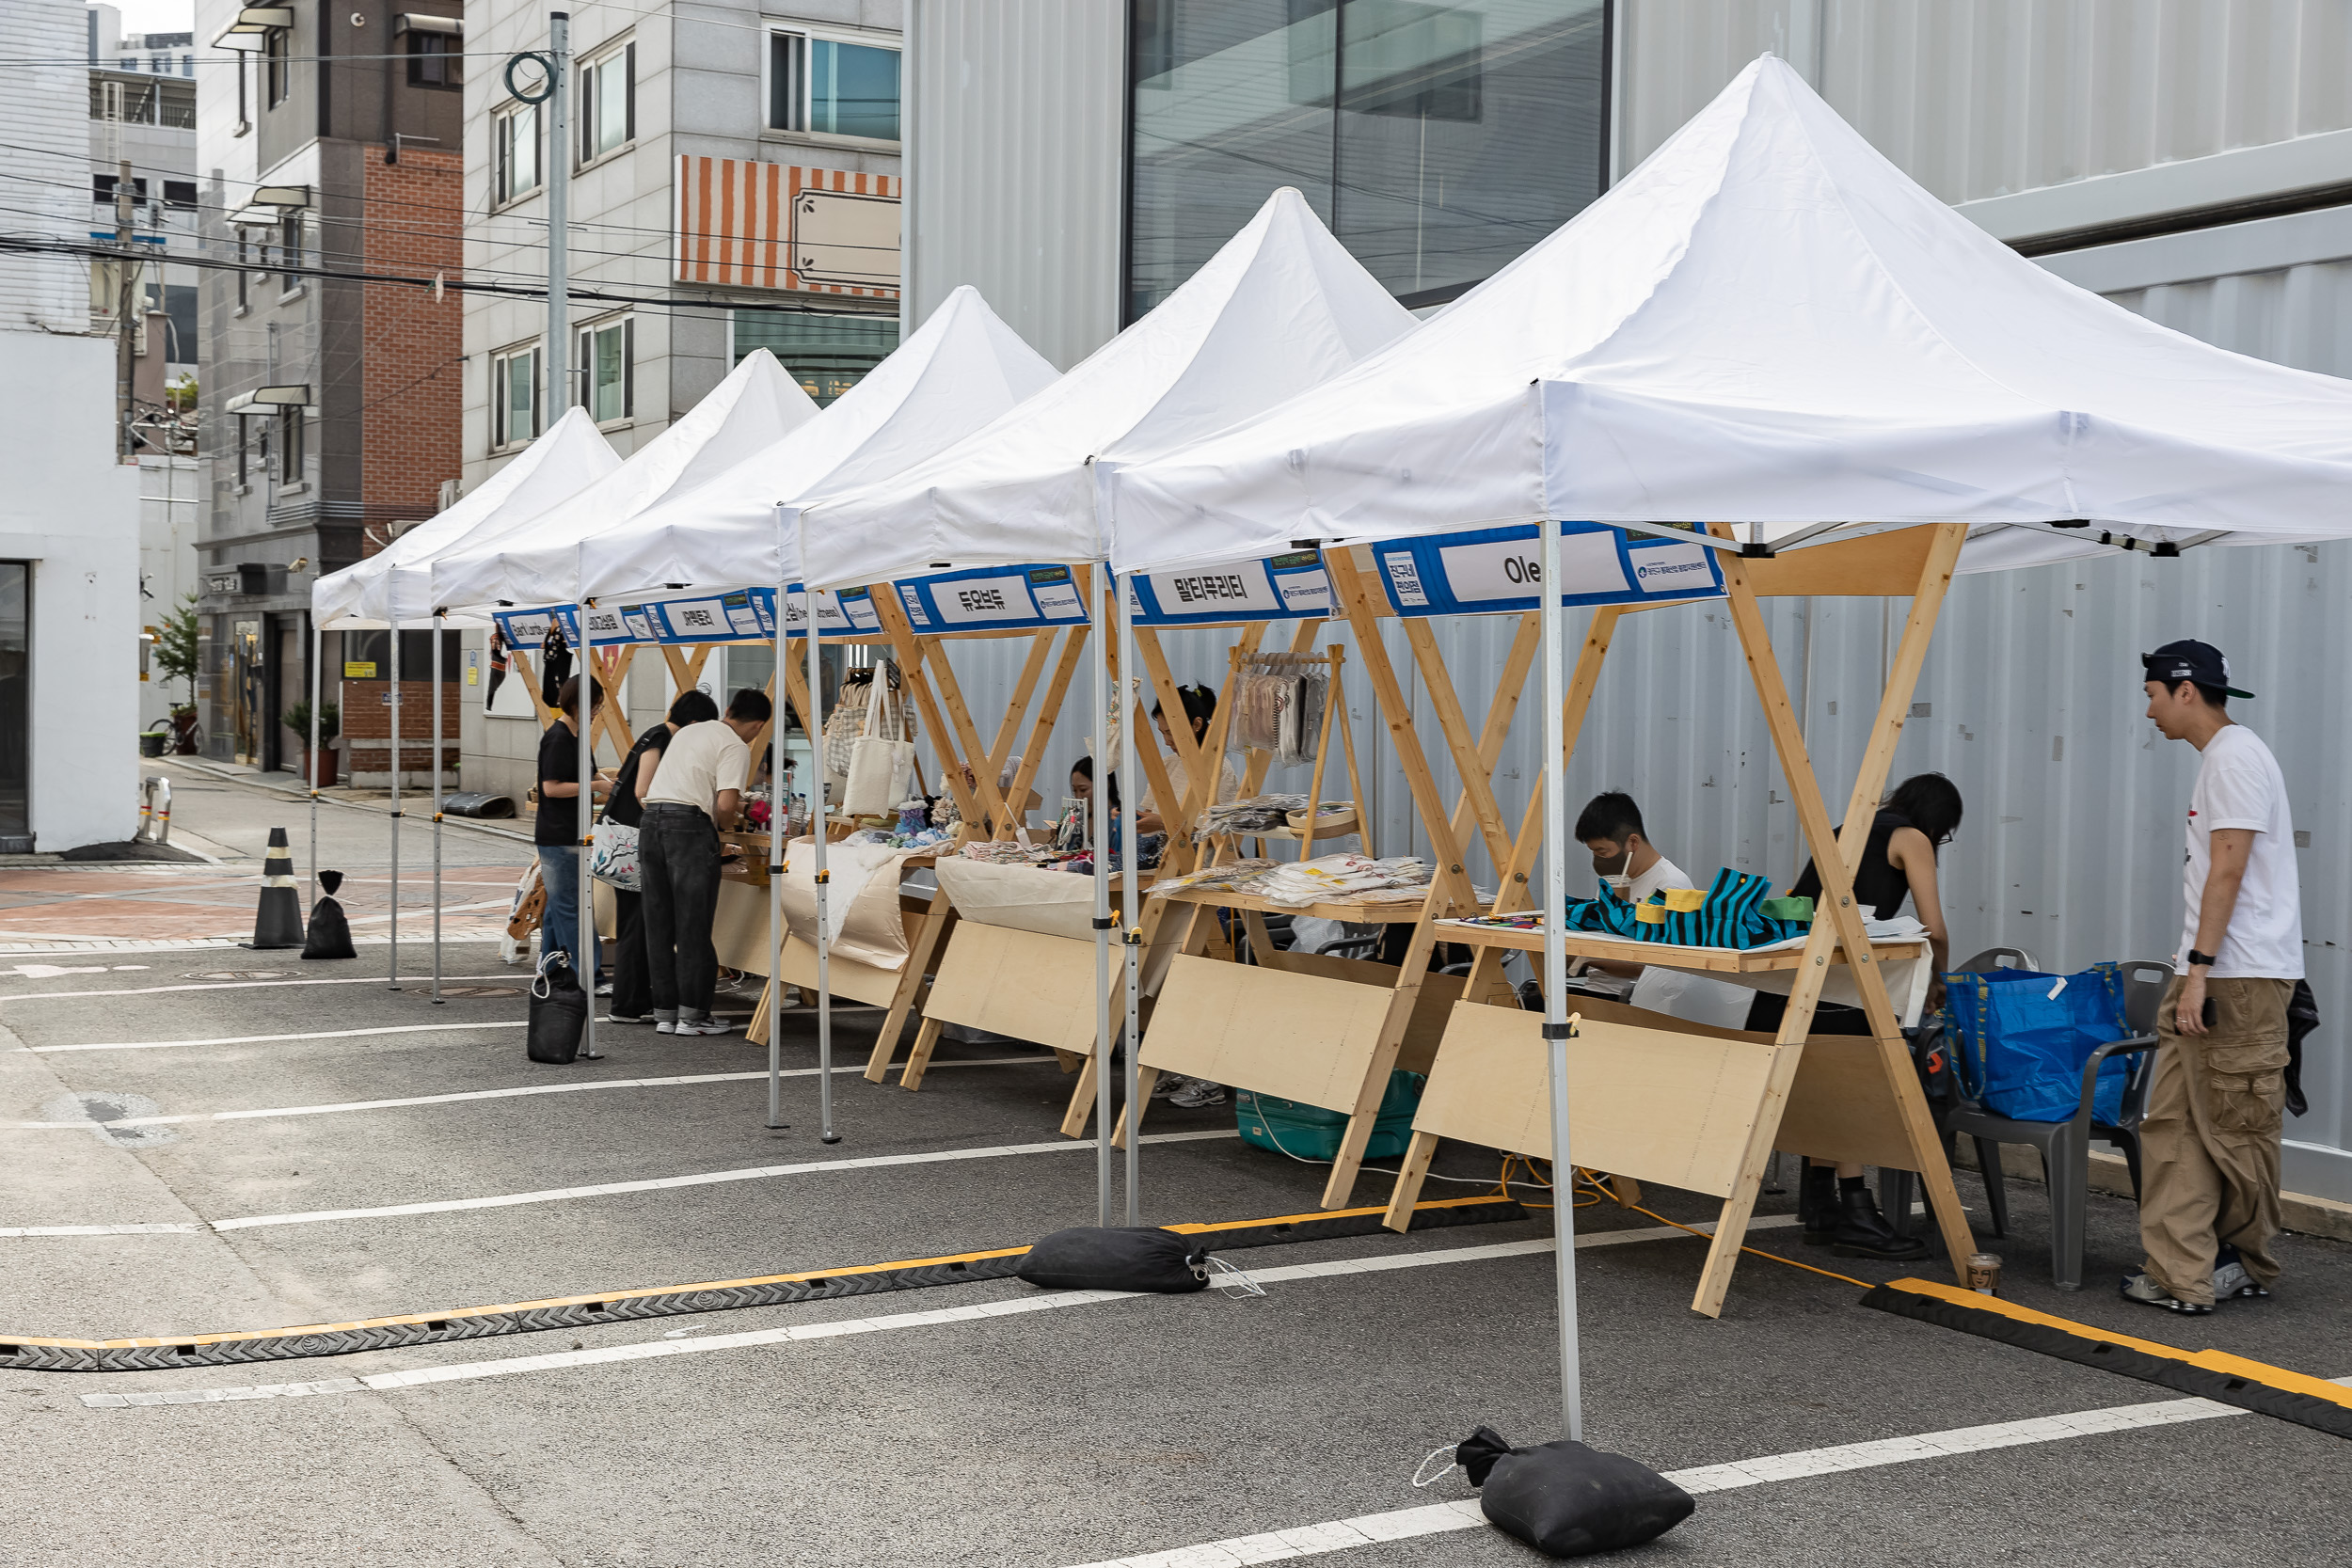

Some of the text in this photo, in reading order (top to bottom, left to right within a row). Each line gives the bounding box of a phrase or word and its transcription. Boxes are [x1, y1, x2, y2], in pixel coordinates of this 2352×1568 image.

[1173, 574, 1248, 602] 말티푸리티
[1395, 580, 1422, 594] 편의점
[958, 589, 1007, 611] 듀오브듀
